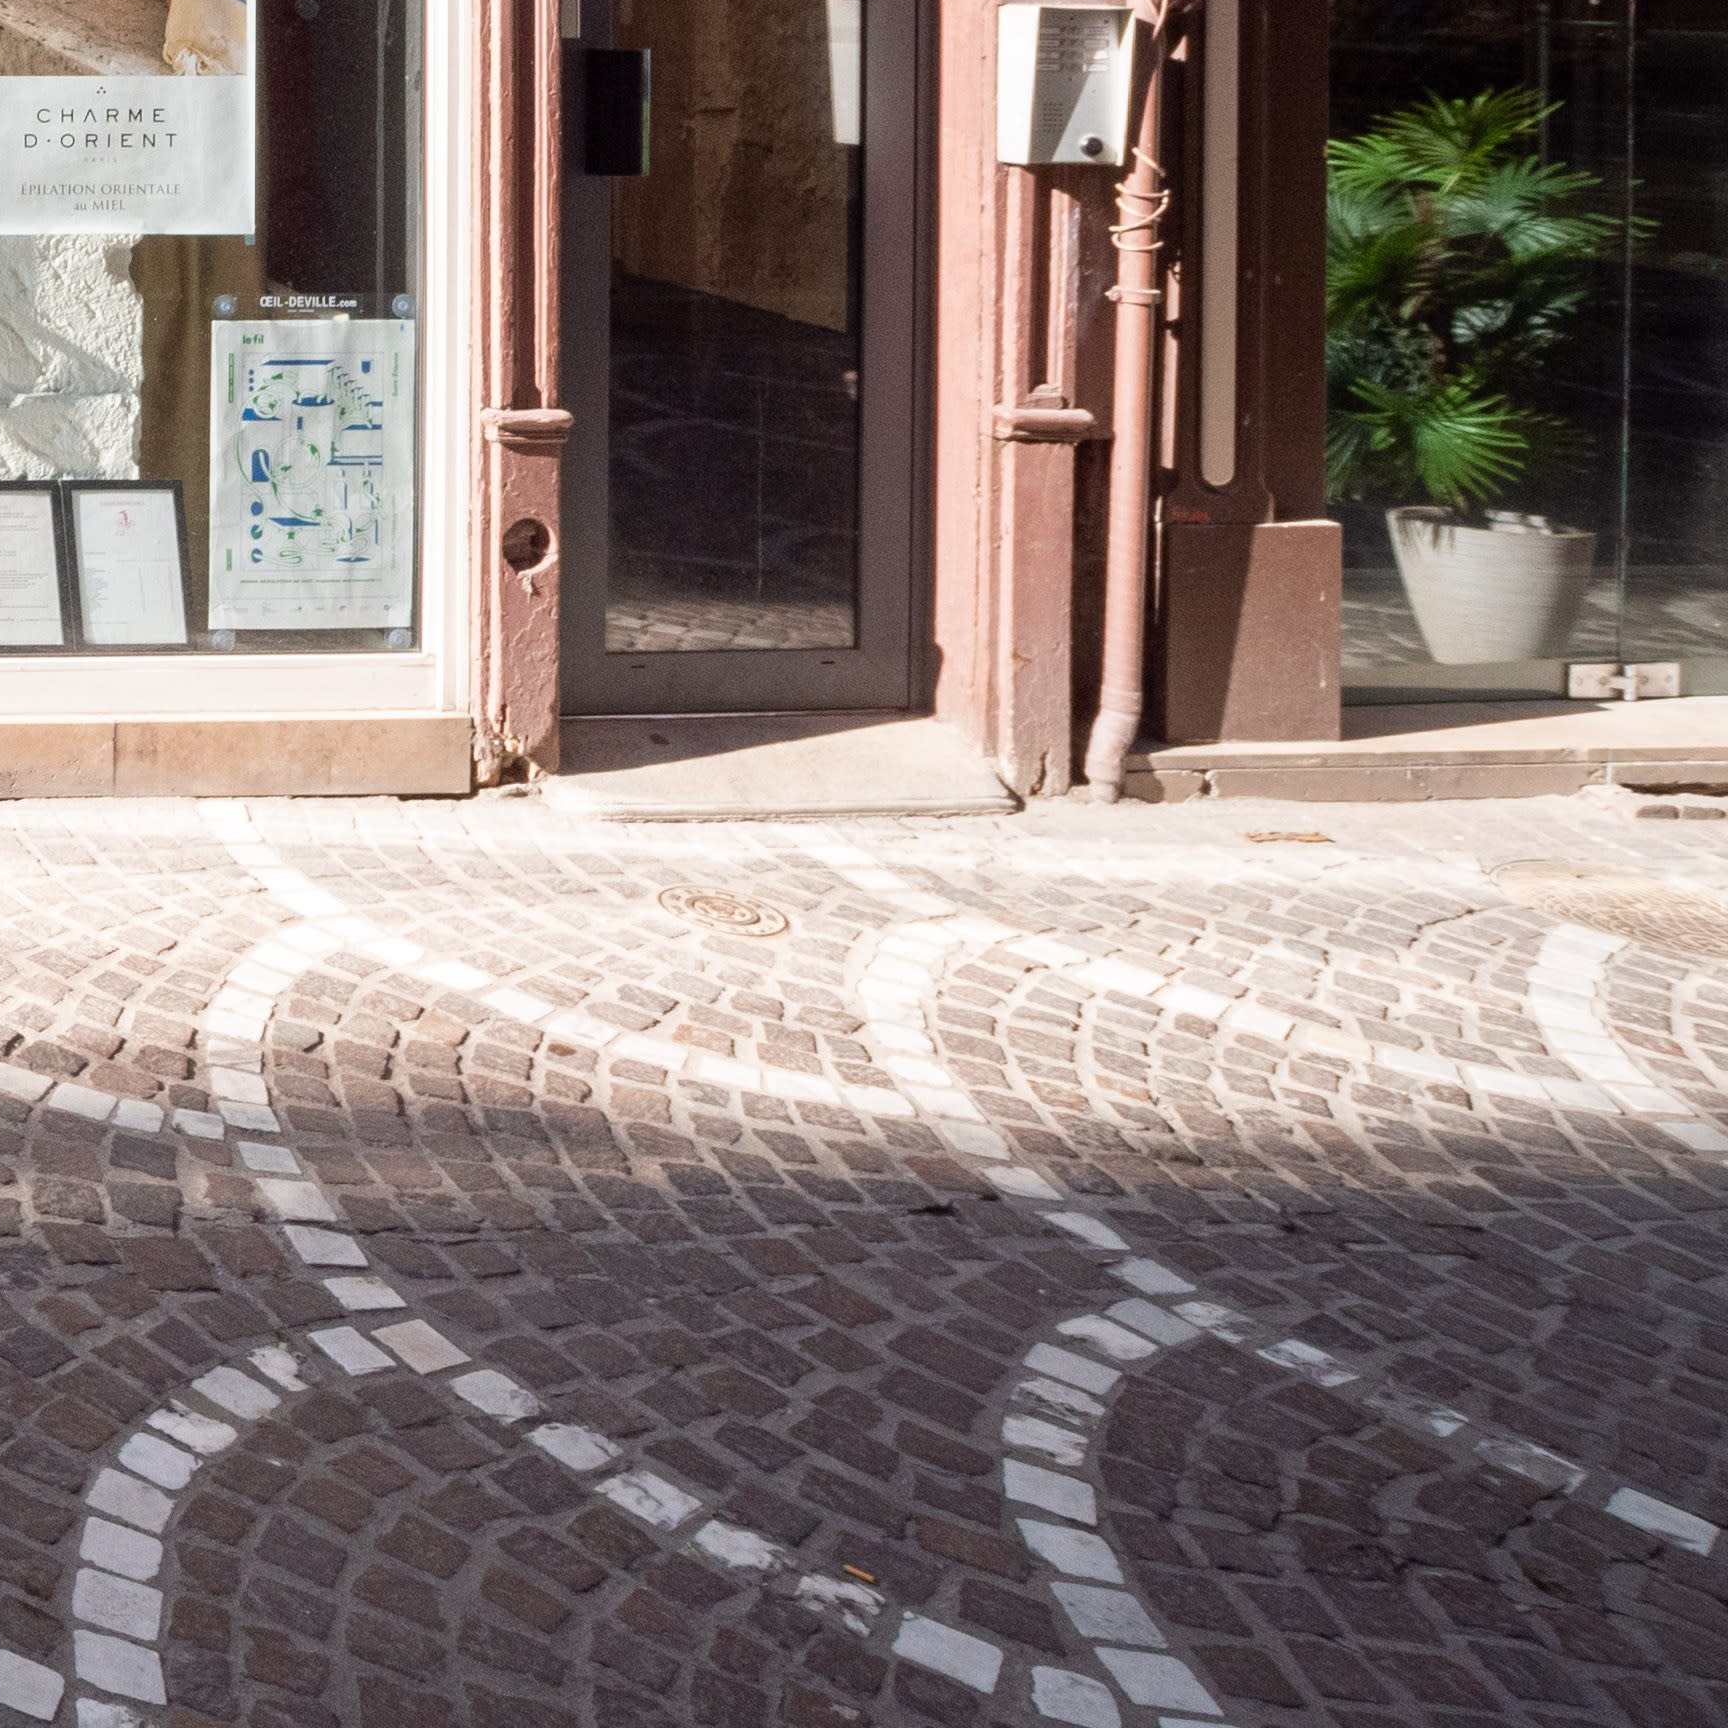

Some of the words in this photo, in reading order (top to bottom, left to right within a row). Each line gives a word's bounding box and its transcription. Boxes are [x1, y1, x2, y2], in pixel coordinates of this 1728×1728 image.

[36, 108, 165, 123] CHARME
[21, 181, 95, 196] ÉPILATION
[100, 183, 181, 195] ORIENTALE
[73, 203, 87, 211] au
[92, 199, 126, 211] MIEL
